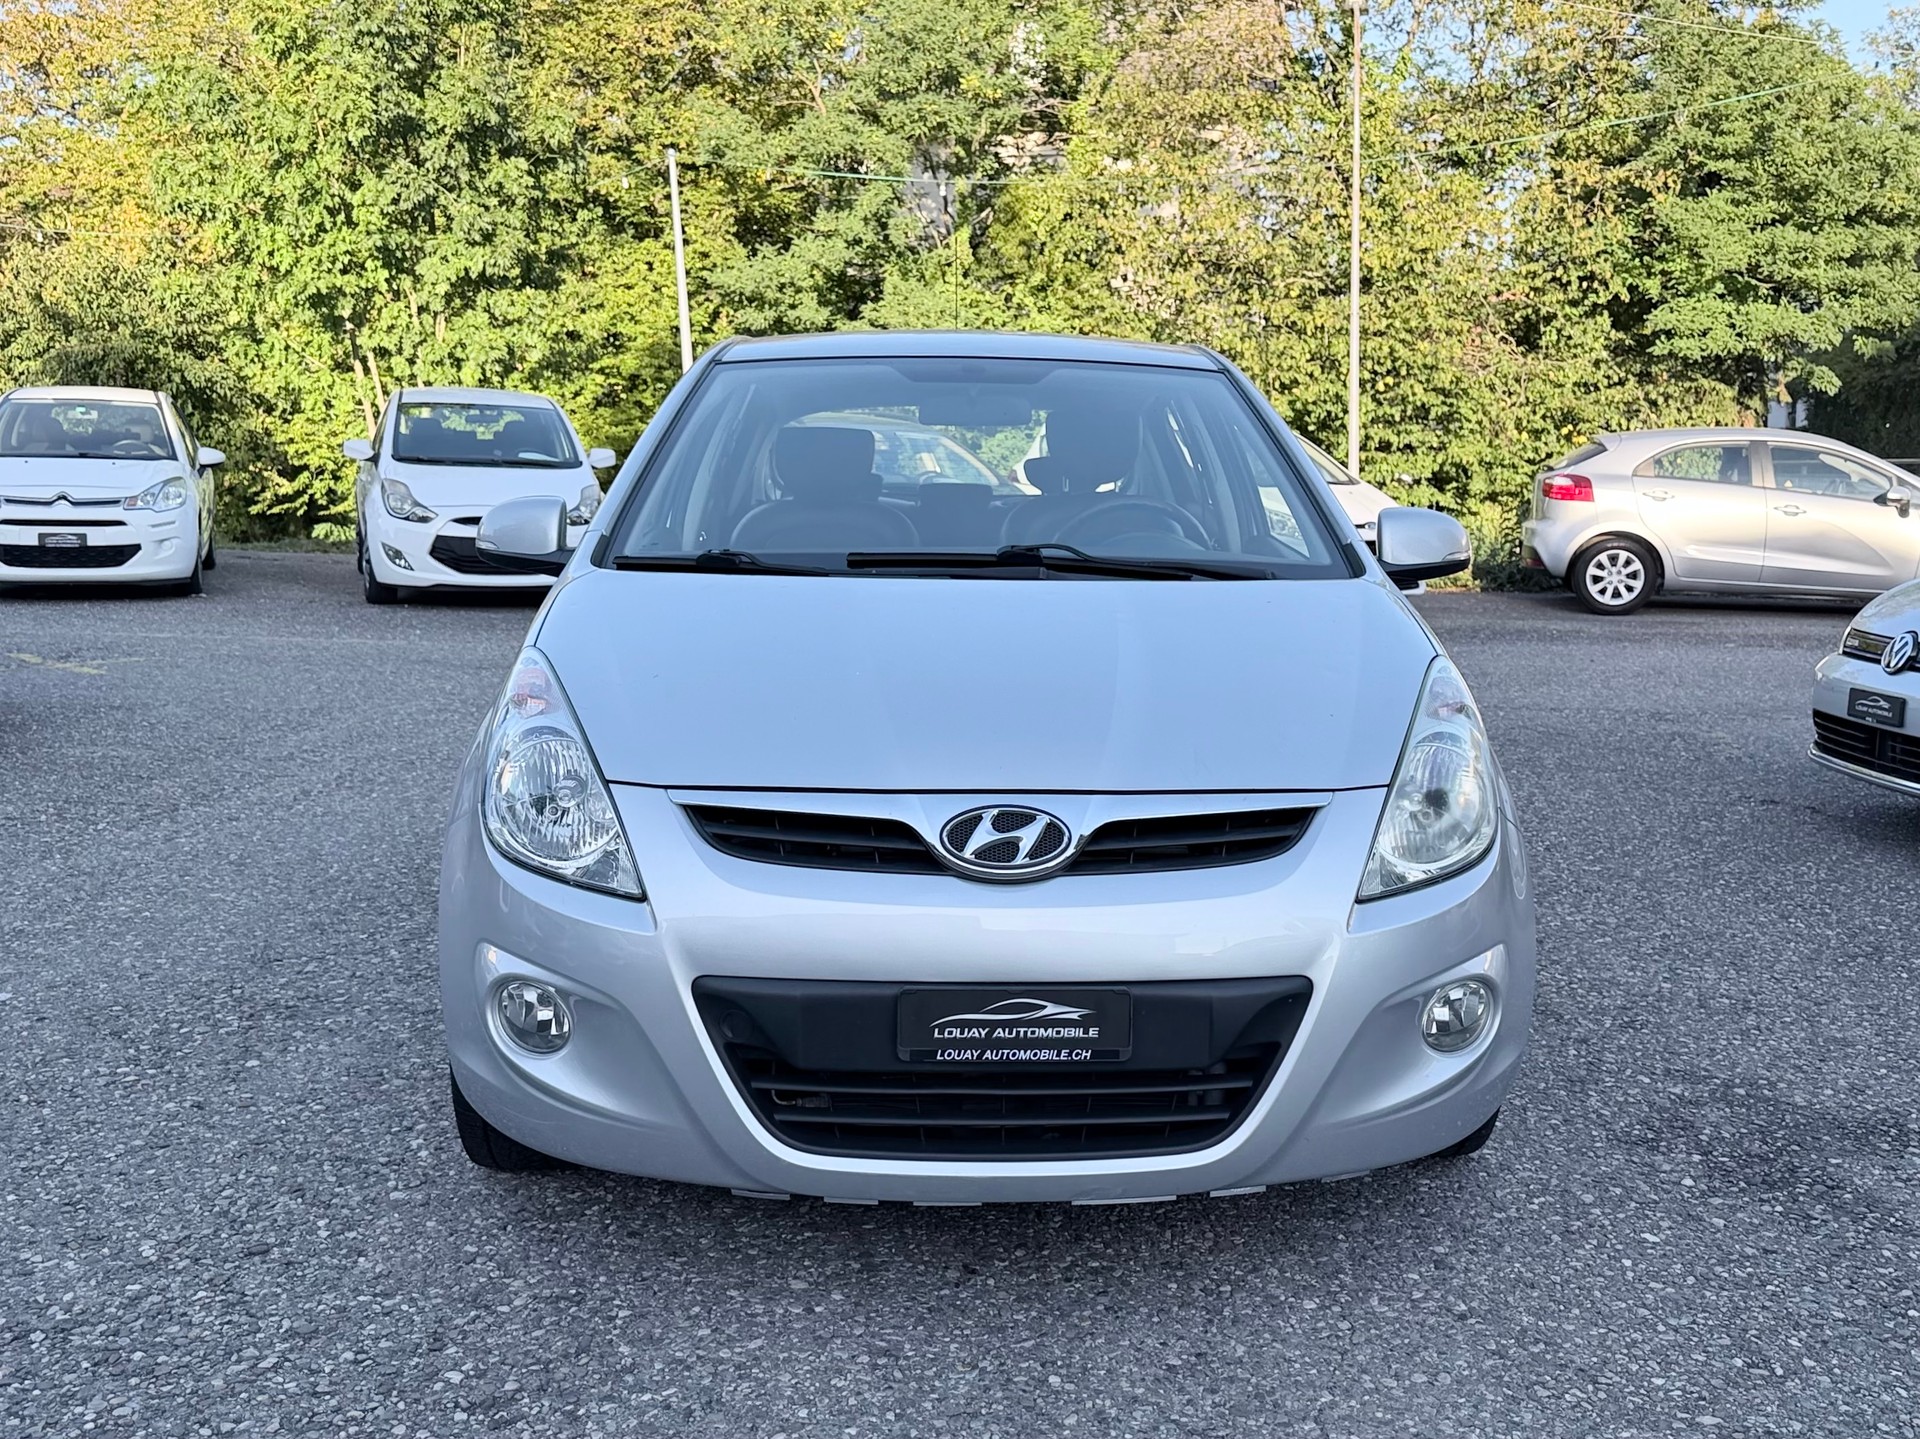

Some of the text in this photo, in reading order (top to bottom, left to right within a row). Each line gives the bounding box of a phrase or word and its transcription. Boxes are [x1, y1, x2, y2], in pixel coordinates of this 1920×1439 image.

[933, 1027, 1100, 1039] LOUAY AUTOMOBILE
[936, 1049, 1092, 1060] LOUAY AUTOMOBILE.CH
